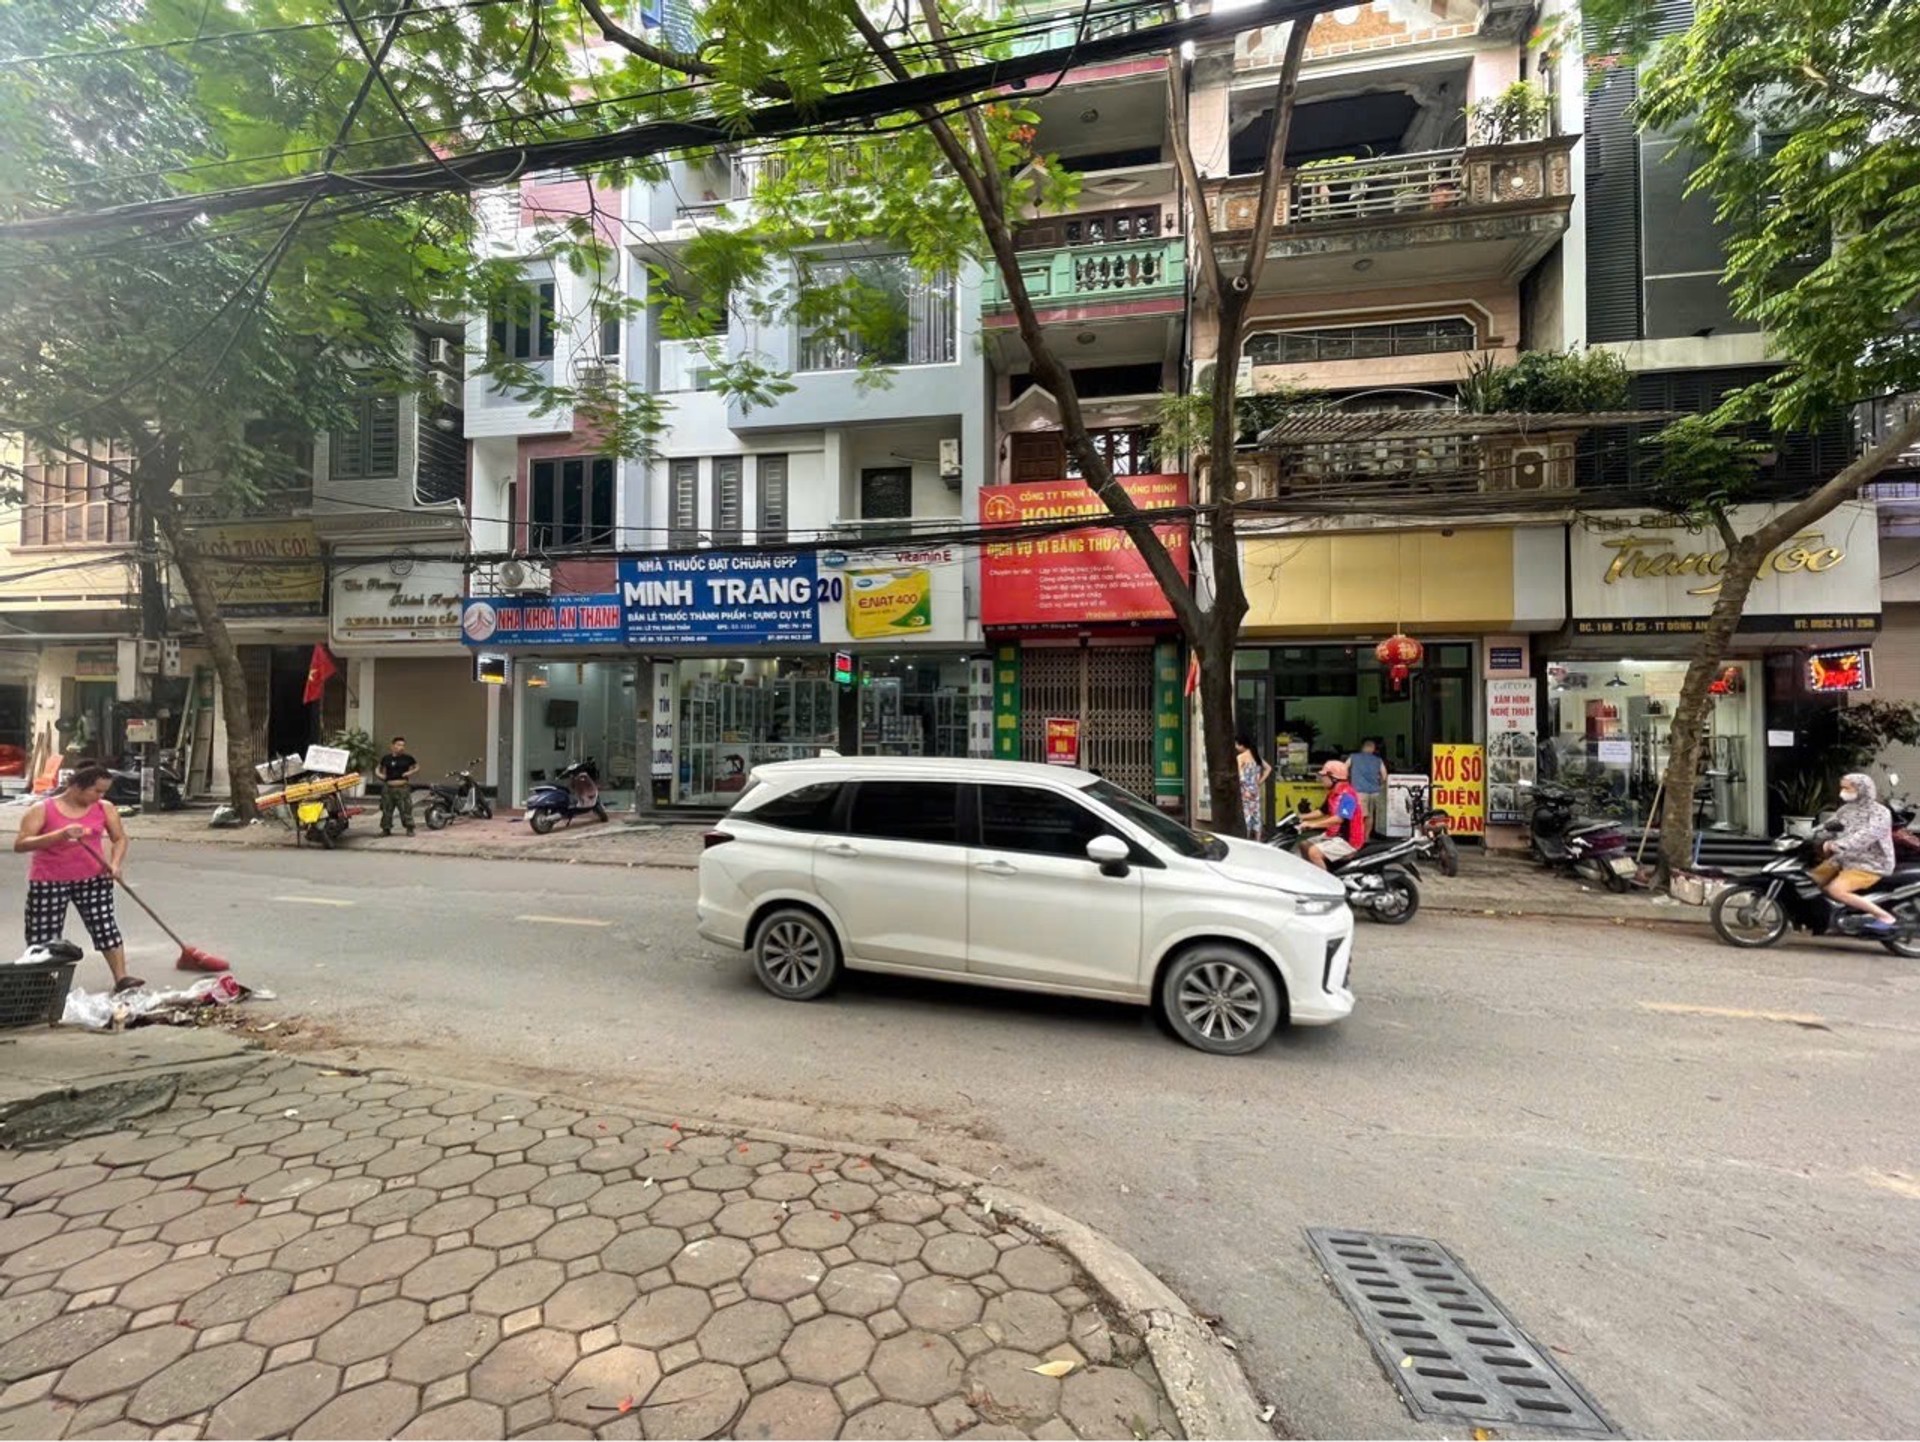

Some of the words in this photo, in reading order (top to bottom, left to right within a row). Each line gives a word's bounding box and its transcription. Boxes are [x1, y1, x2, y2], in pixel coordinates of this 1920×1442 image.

[637, 557, 663, 572] NHÀ
[667, 556, 706, 571] THUỐC
[708, 557, 729, 572] ĐẠT
[624, 580, 694, 607] MINH
[707, 578, 811, 605] TRANG
[817, 577, 843, 603] 20
[858, 595, 894, 609] ENAT
[896, 593, 918, 605] 400
[497, 607, 522, 631] NHA
[524, 606, 557, 631] KHOA
[558, 606, 577, 630] AN
[1434, 746, 1456, 782] XỔ
[1461, 747, 1482, 782] SỐ
[1436, 786, 1481, 809] ĐIỆN
